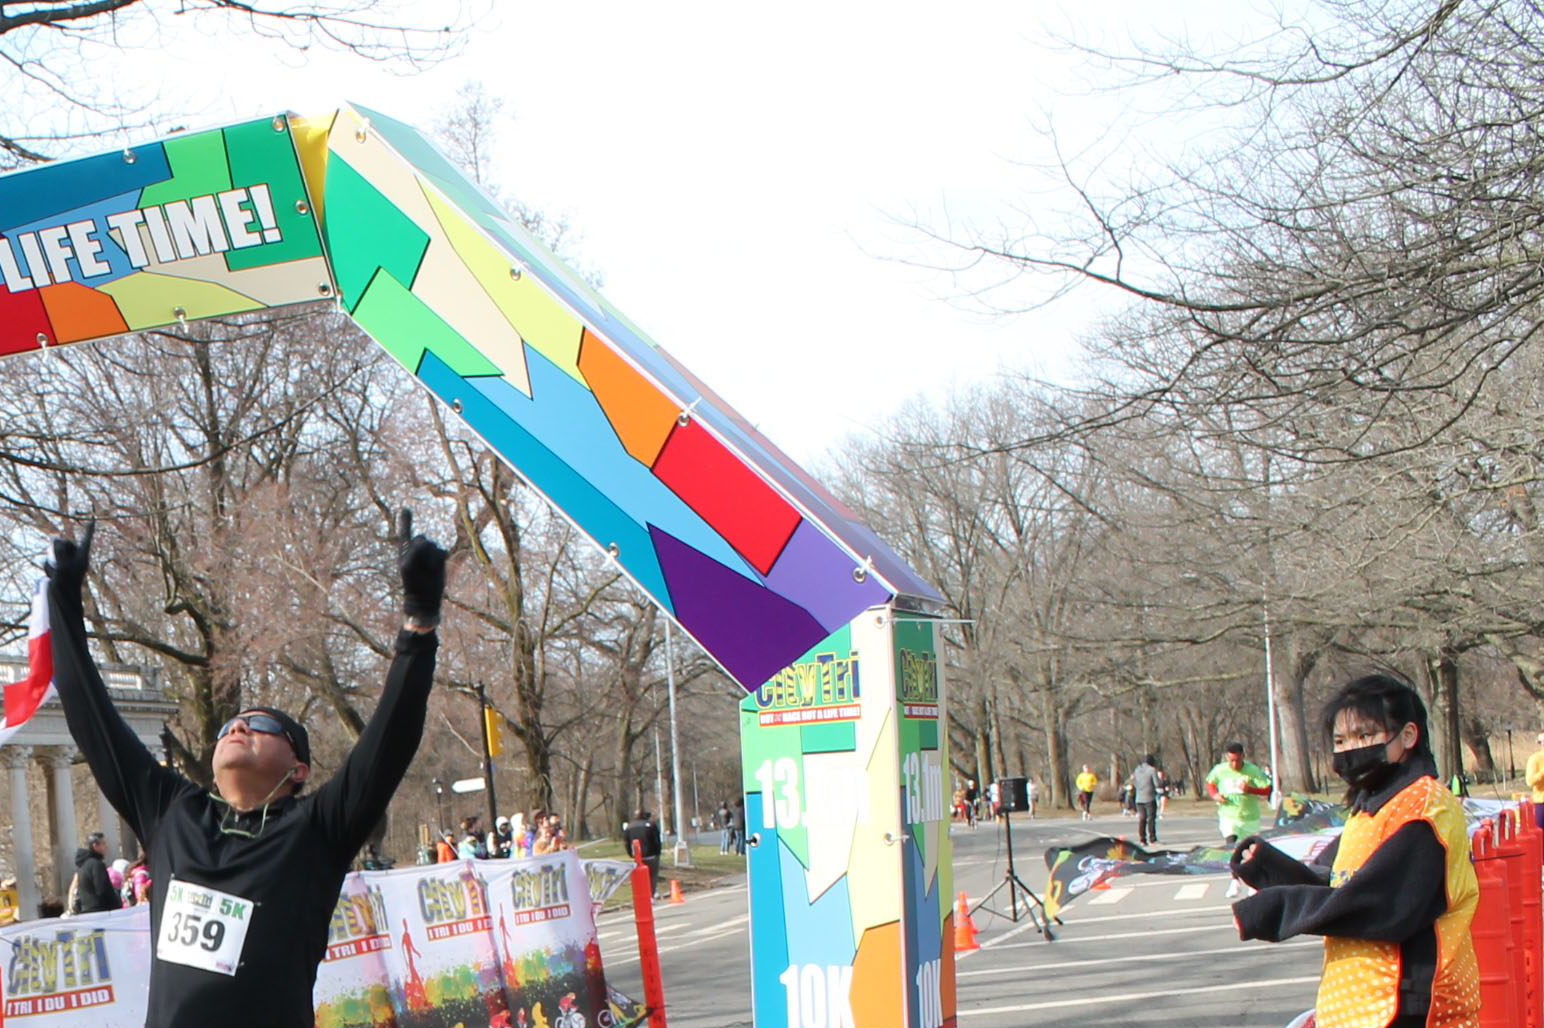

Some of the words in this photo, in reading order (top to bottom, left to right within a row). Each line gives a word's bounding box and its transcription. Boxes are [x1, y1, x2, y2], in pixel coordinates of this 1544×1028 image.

[109, 185, 283, 266] TIME!
[219, 898, 247, 920] 5K
[168, 911, 226, 952] 359
[428, 929, 434, 940] I
[434, 925, 450, 939] TRI
[453, 924, 458, 935] I
[477, 919, 482, 930] I
[7, 928, 112, 996] CityTri
[331, 943, 357, 958] TRI
[7, 1001, 13, 1017] I
[14, 1000, 33, 1016] TRI
[37, 998, 43, 1012] I
[70, 993, 77, 1008] I
[80, 989, 110, 1006] DID
